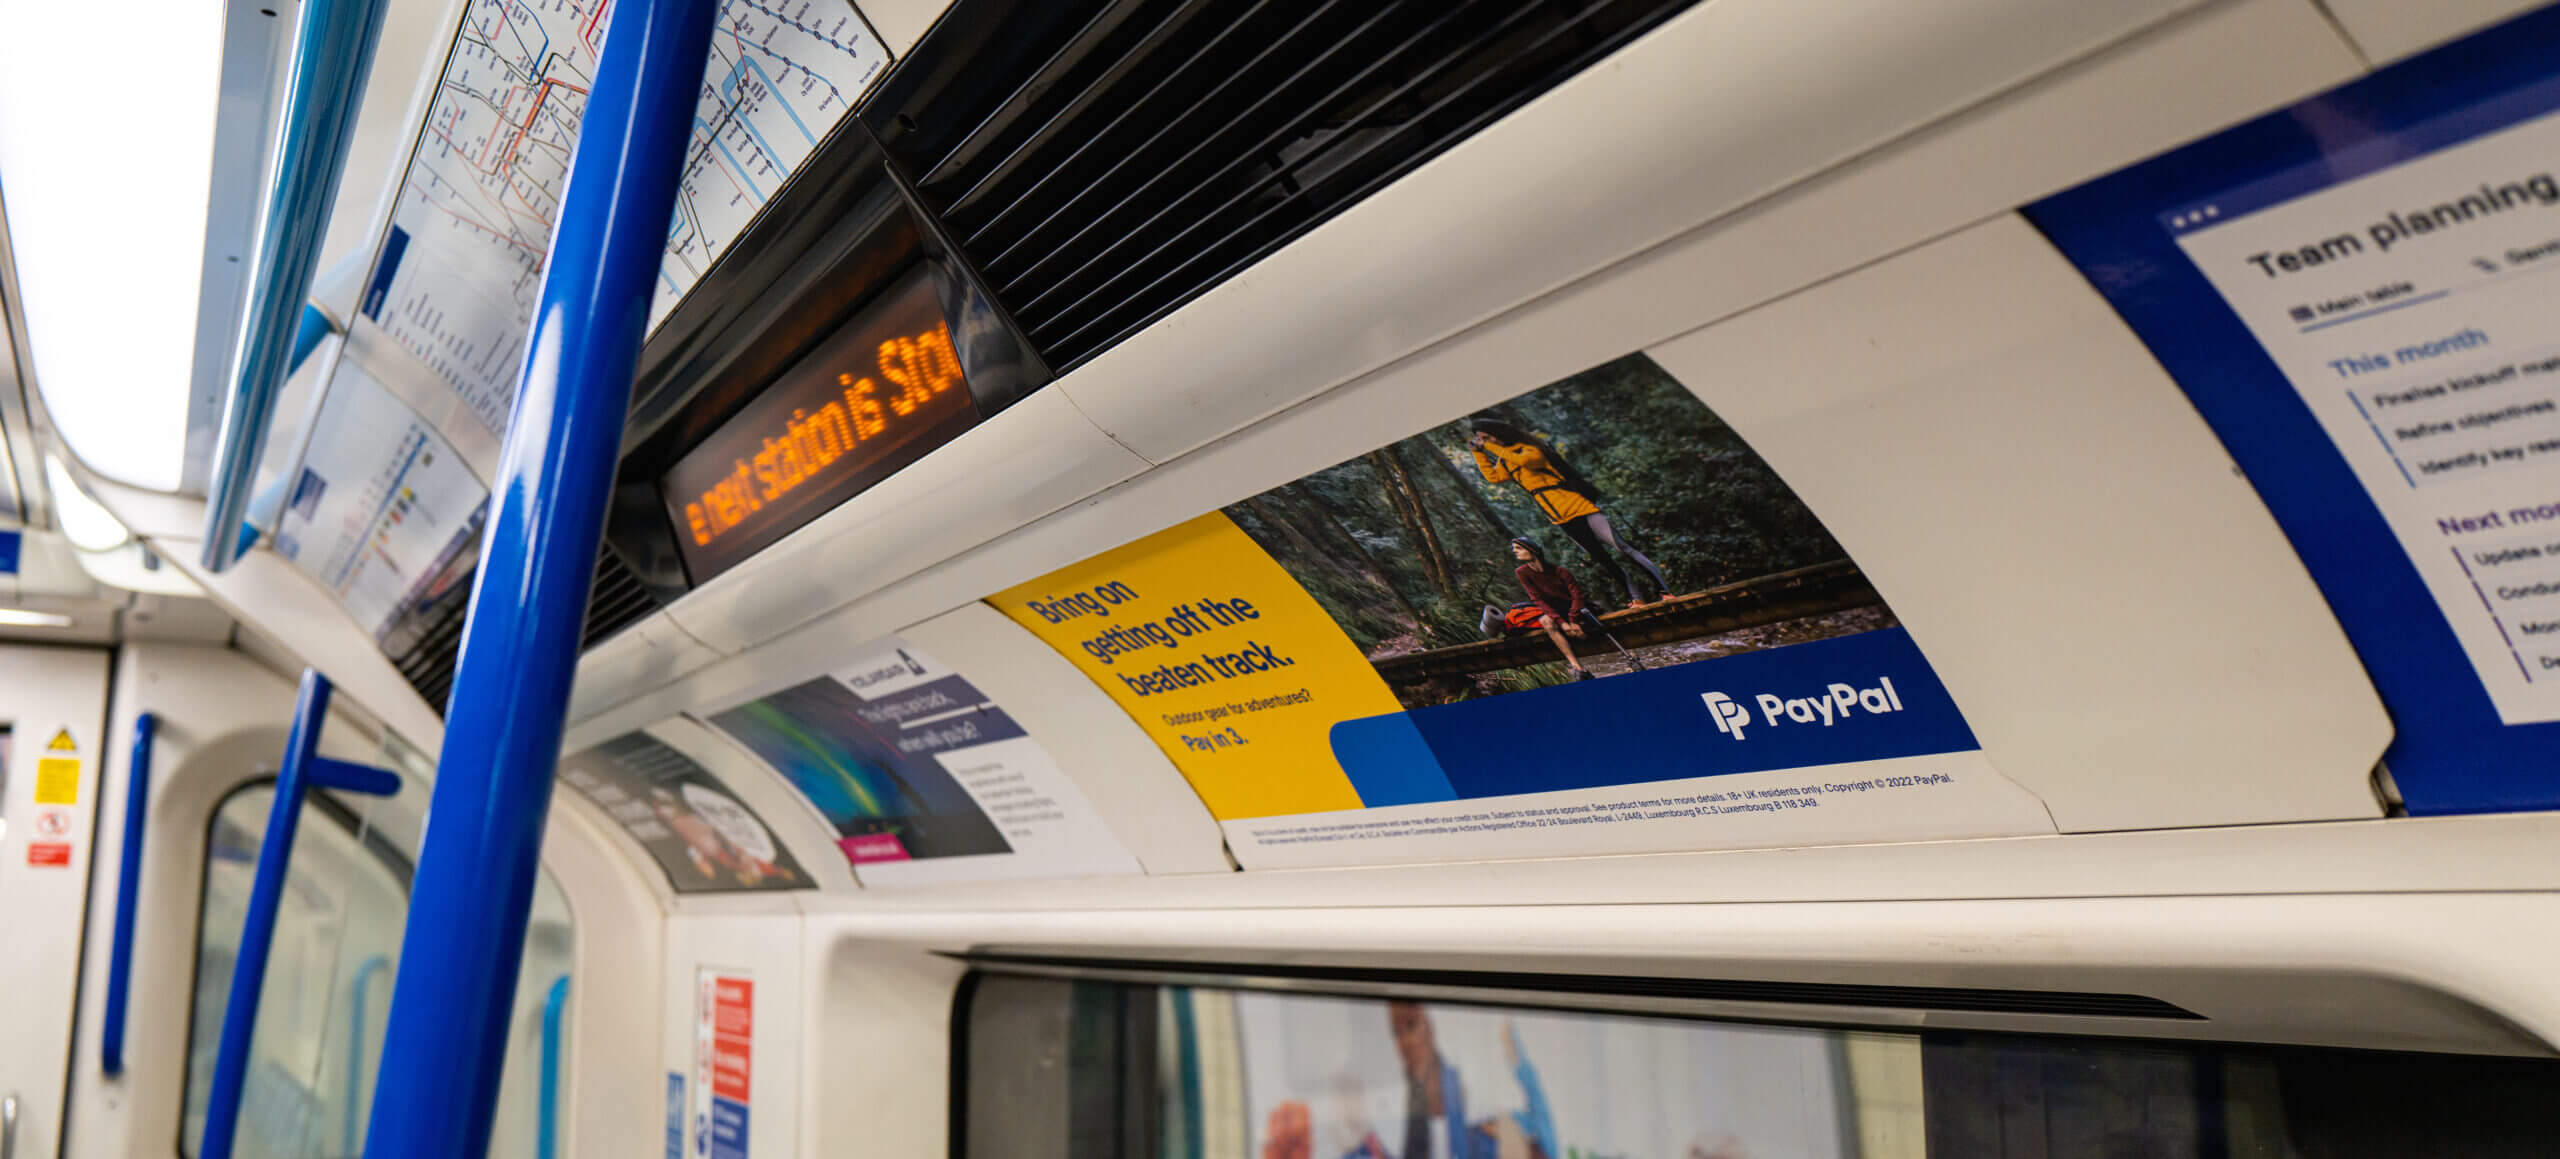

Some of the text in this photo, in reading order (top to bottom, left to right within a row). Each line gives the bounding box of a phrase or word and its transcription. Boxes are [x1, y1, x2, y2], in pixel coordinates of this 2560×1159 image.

[2246, 233, 2363, 278] Team
[2328, 328, 2490, 378] This month
[2373, 384, 2447, 407] Finalise
[2396, 399, 2556, 441] Refine objectives
[702, 459, 763, 537] next
[753, 401, 856, 501] station
[839, 372, 886, 441] is
[2437, 510, 2504, 536] Next
[2474, 547, 2541, 566] Update
[1026, 580, 1139, 624] Bring on
[1081, 597, 1260, 665] getting off the
[1116, 641, 1296, 697] beaten track.
[1162, 688, 1314, 727] Outdoor gear for adventures?
[1755, 676, 1904, 727] PayPal
[1180, 727, 1250, 753] Pay in 3.
[1607, 800, 1638, 812] product
[1638, 798, 1661, 808] terms
[1661, 796, 1673, 806] for
[1673, 796, 1696, 806] more
[1697, 792, 1726, 804] details.
[1726, 790, 1742, 801] 18+
[1742, 789, 1758, 800] UK
[1758, 786, 1800, 799] residents
[1801, 784, 1824, 798] only.
[1824, 780, 1874, 793] Copyright
[1885, 775, 1914, 788] 2022
[1914, 772, 1955, 787] PayPal.
[1645, 805, 1696, 819] Luxembourg
[1718, 801, 1775, 815] Luxembourg
[1774, 800, 1783, 811] B
[1783, 799, 1798, 810] 118
[1799, 797, 1820, 809] 349.
